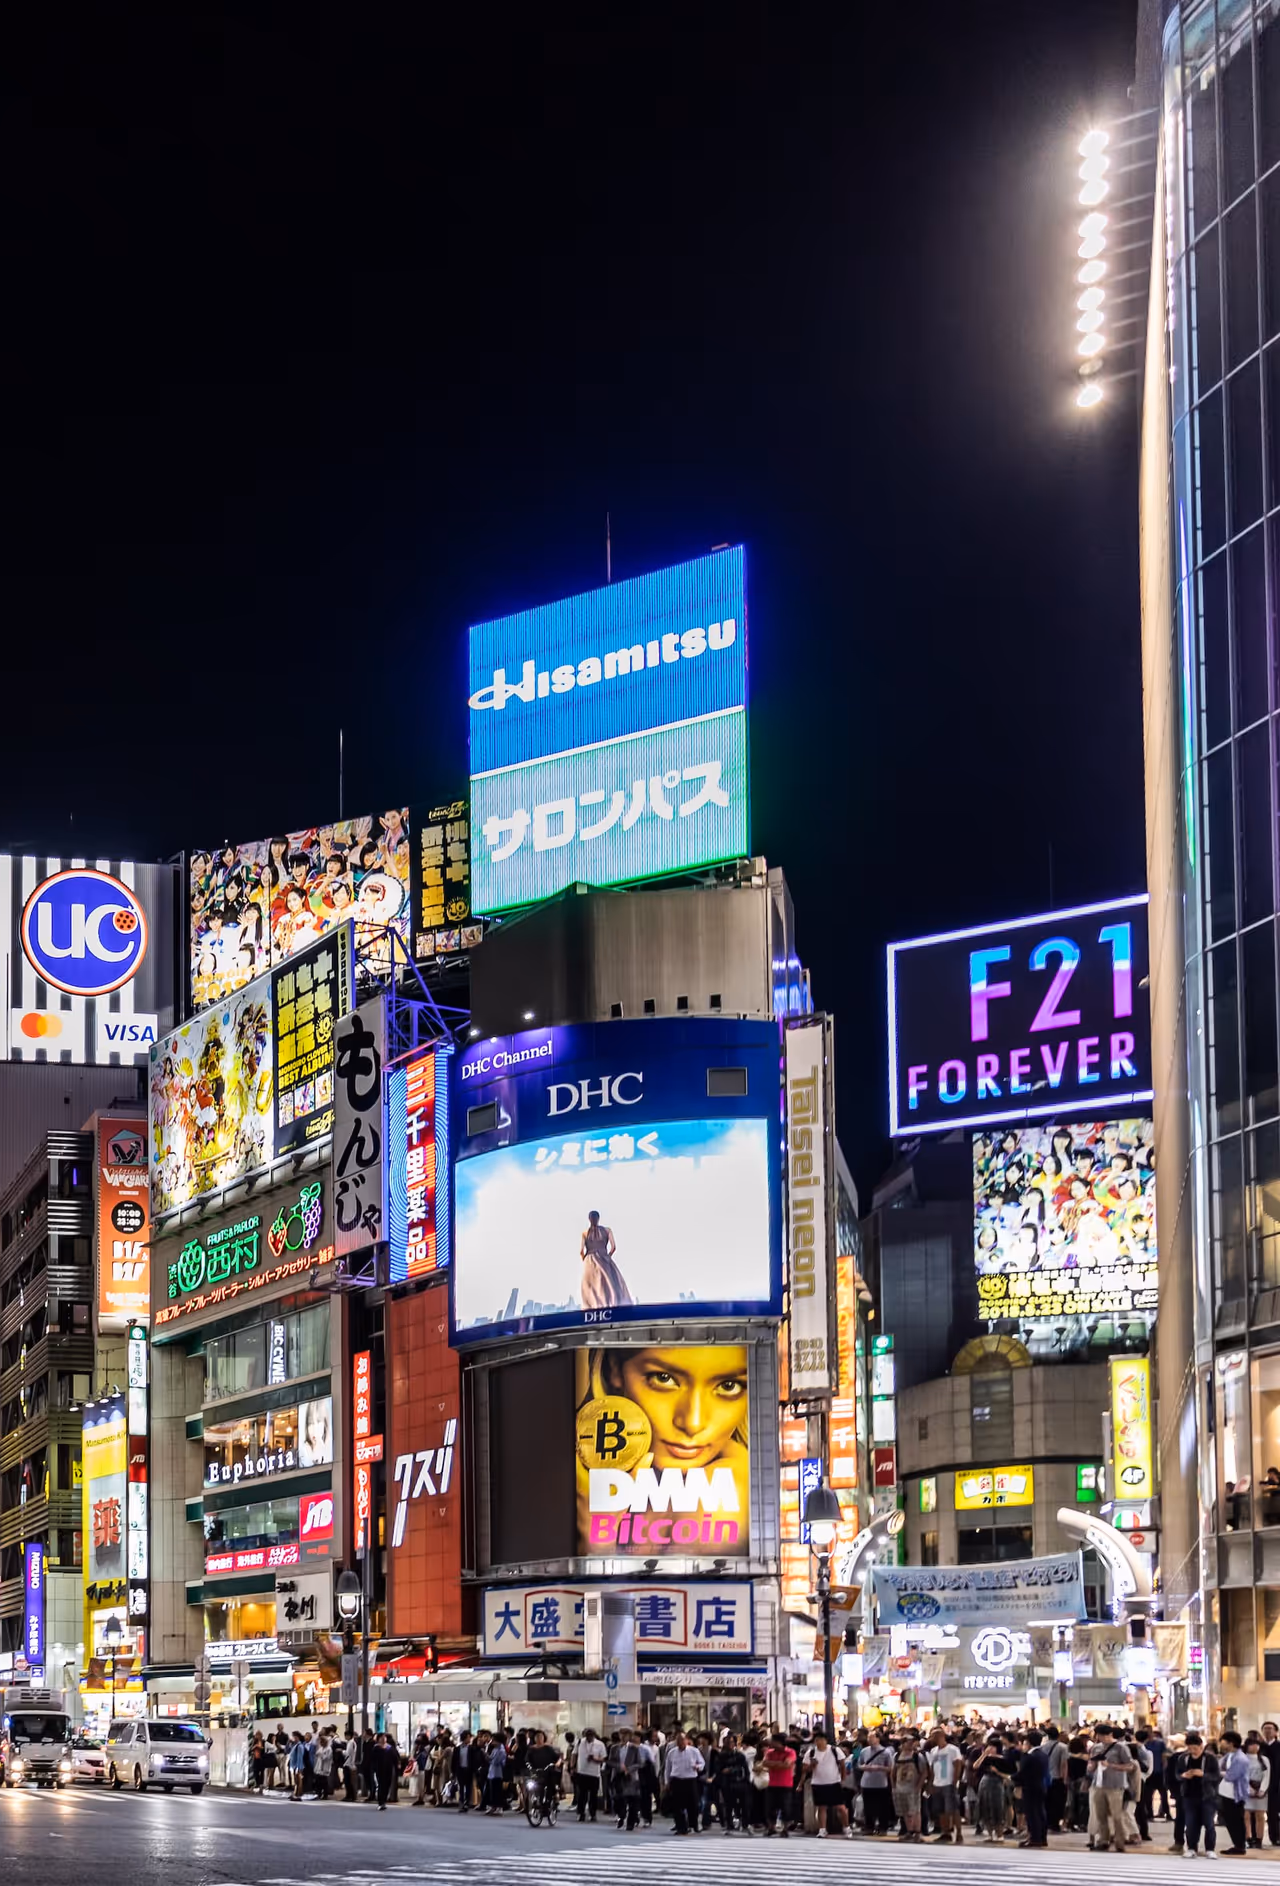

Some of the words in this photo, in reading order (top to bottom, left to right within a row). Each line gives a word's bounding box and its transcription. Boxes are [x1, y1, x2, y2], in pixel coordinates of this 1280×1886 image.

[467, 618, 737, 712] Hisamitsu
[482, 761, 729, 863] サロンパス
[969, 921, 1134, 1043] F21
[104, 1023, 155, 1043] VISA
[278, 1068, 300, 1090] BEST
[461, 1057, 491, 1080] DHC
[492, 1041, 553, 1070] Channel
[907, 1031, 1138, 1111] FOREVER
[546, 1071, 645, 1117] DHC
[336, 1014, 382, 1240] もんじゃ
[789, 1065, 820, 1189] Taisei
[405, 1064, 427, 1264] 三千里薬品
[206, 1231, 260, 1284] 西村
[791, 1198, 817, 1300] neon
[168, 1263, 178, 1299] 渋谷
[583, 1309, 613, 1323] DHC
[978, 1302, 1063, 1320] 2018.5.23
[1063, 1299, 1091, 1315] ON
[208, 1448, 295, 1483] Euphoria
[876, 1461, 894, 1473] JTB
[588, 1467, 740, 1513] DMM
[301, 1498, 333, 1535] JTB
[588, 1513, 739, 1545] Bitcoin
[31, 1551, 40, 1590] MIZUHO
[494, 1596, 737, 1642] 大盛書店
